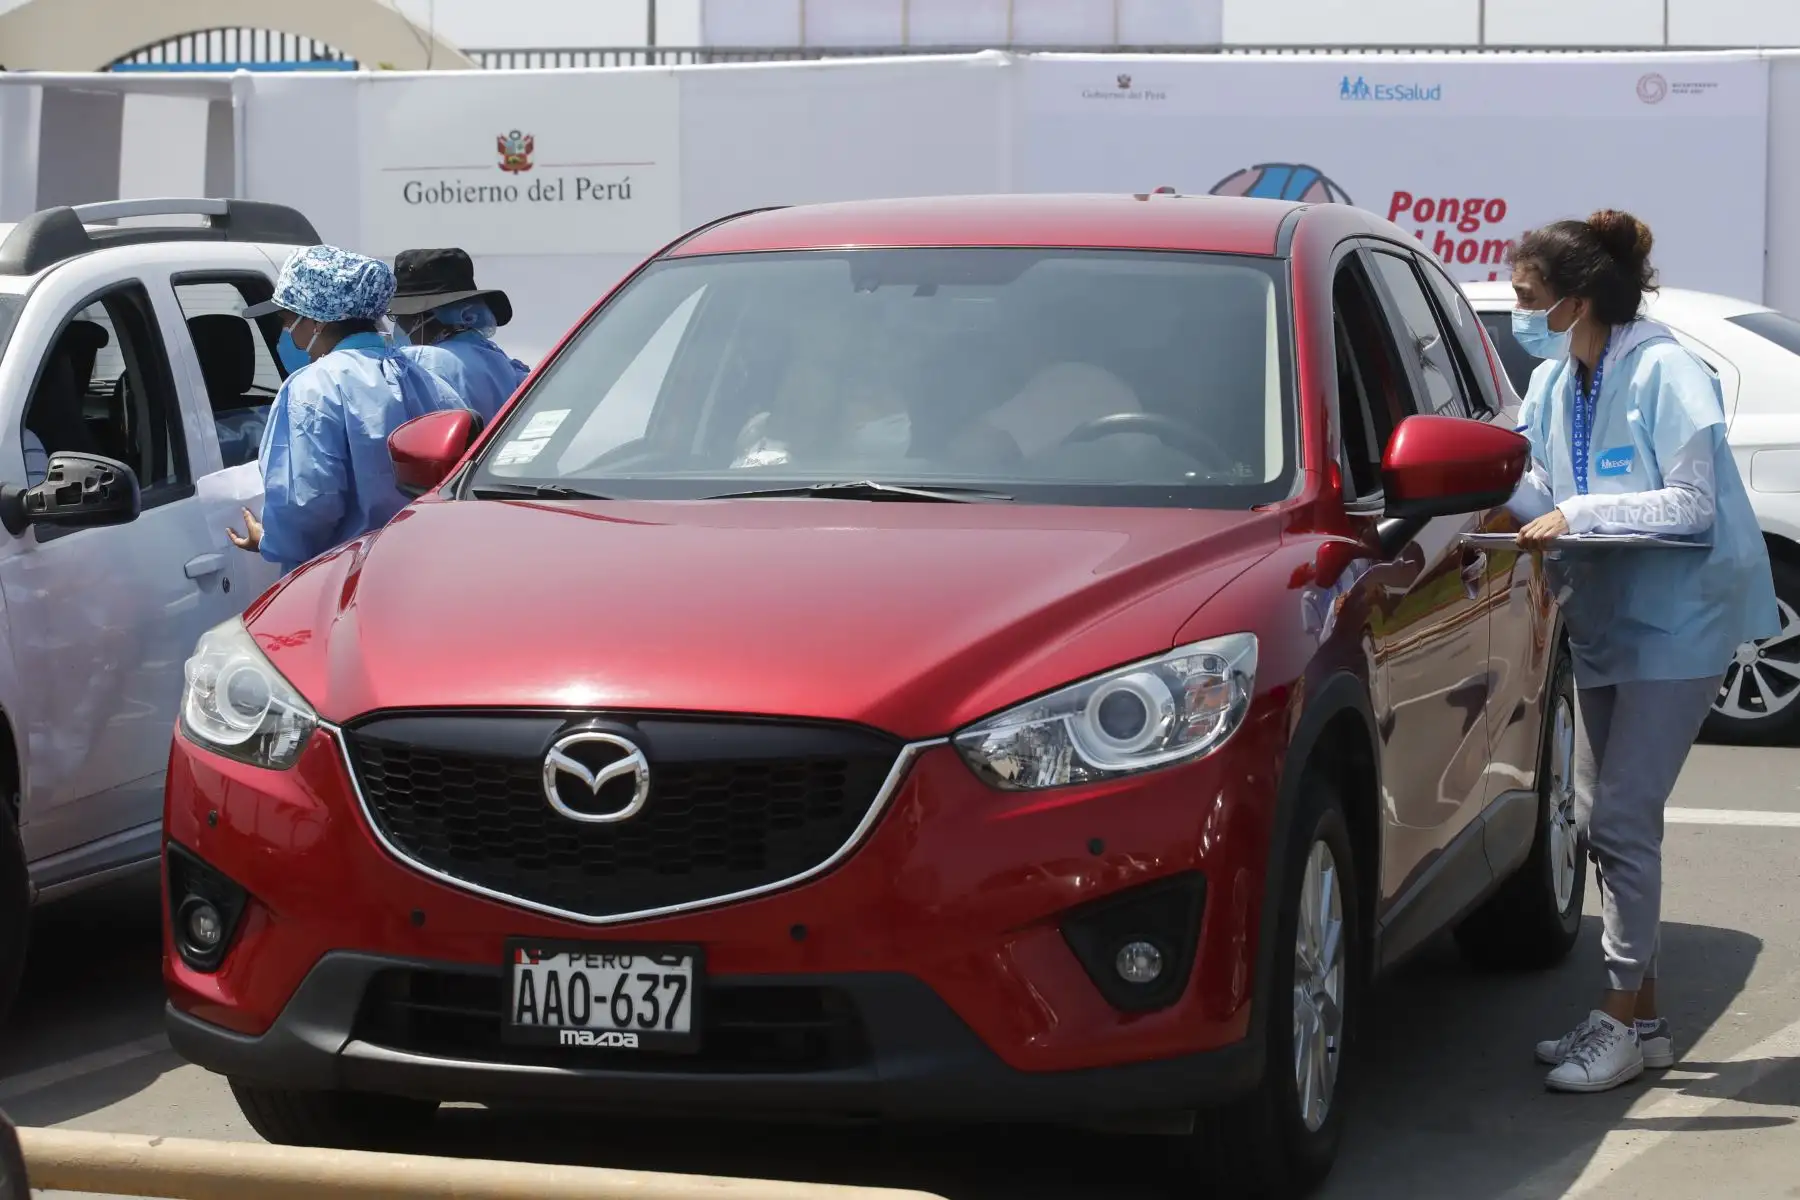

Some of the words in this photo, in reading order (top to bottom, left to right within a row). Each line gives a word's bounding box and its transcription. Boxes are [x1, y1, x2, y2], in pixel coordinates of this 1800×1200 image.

[1374, 83, 1441, 101] EsSalud
[403, 179, 518, 205] Gobierno
[528, 177, 564, 202] del
[575, 176, 632, 201] Perú
[1387, 190, 1507, 233] Pongo
